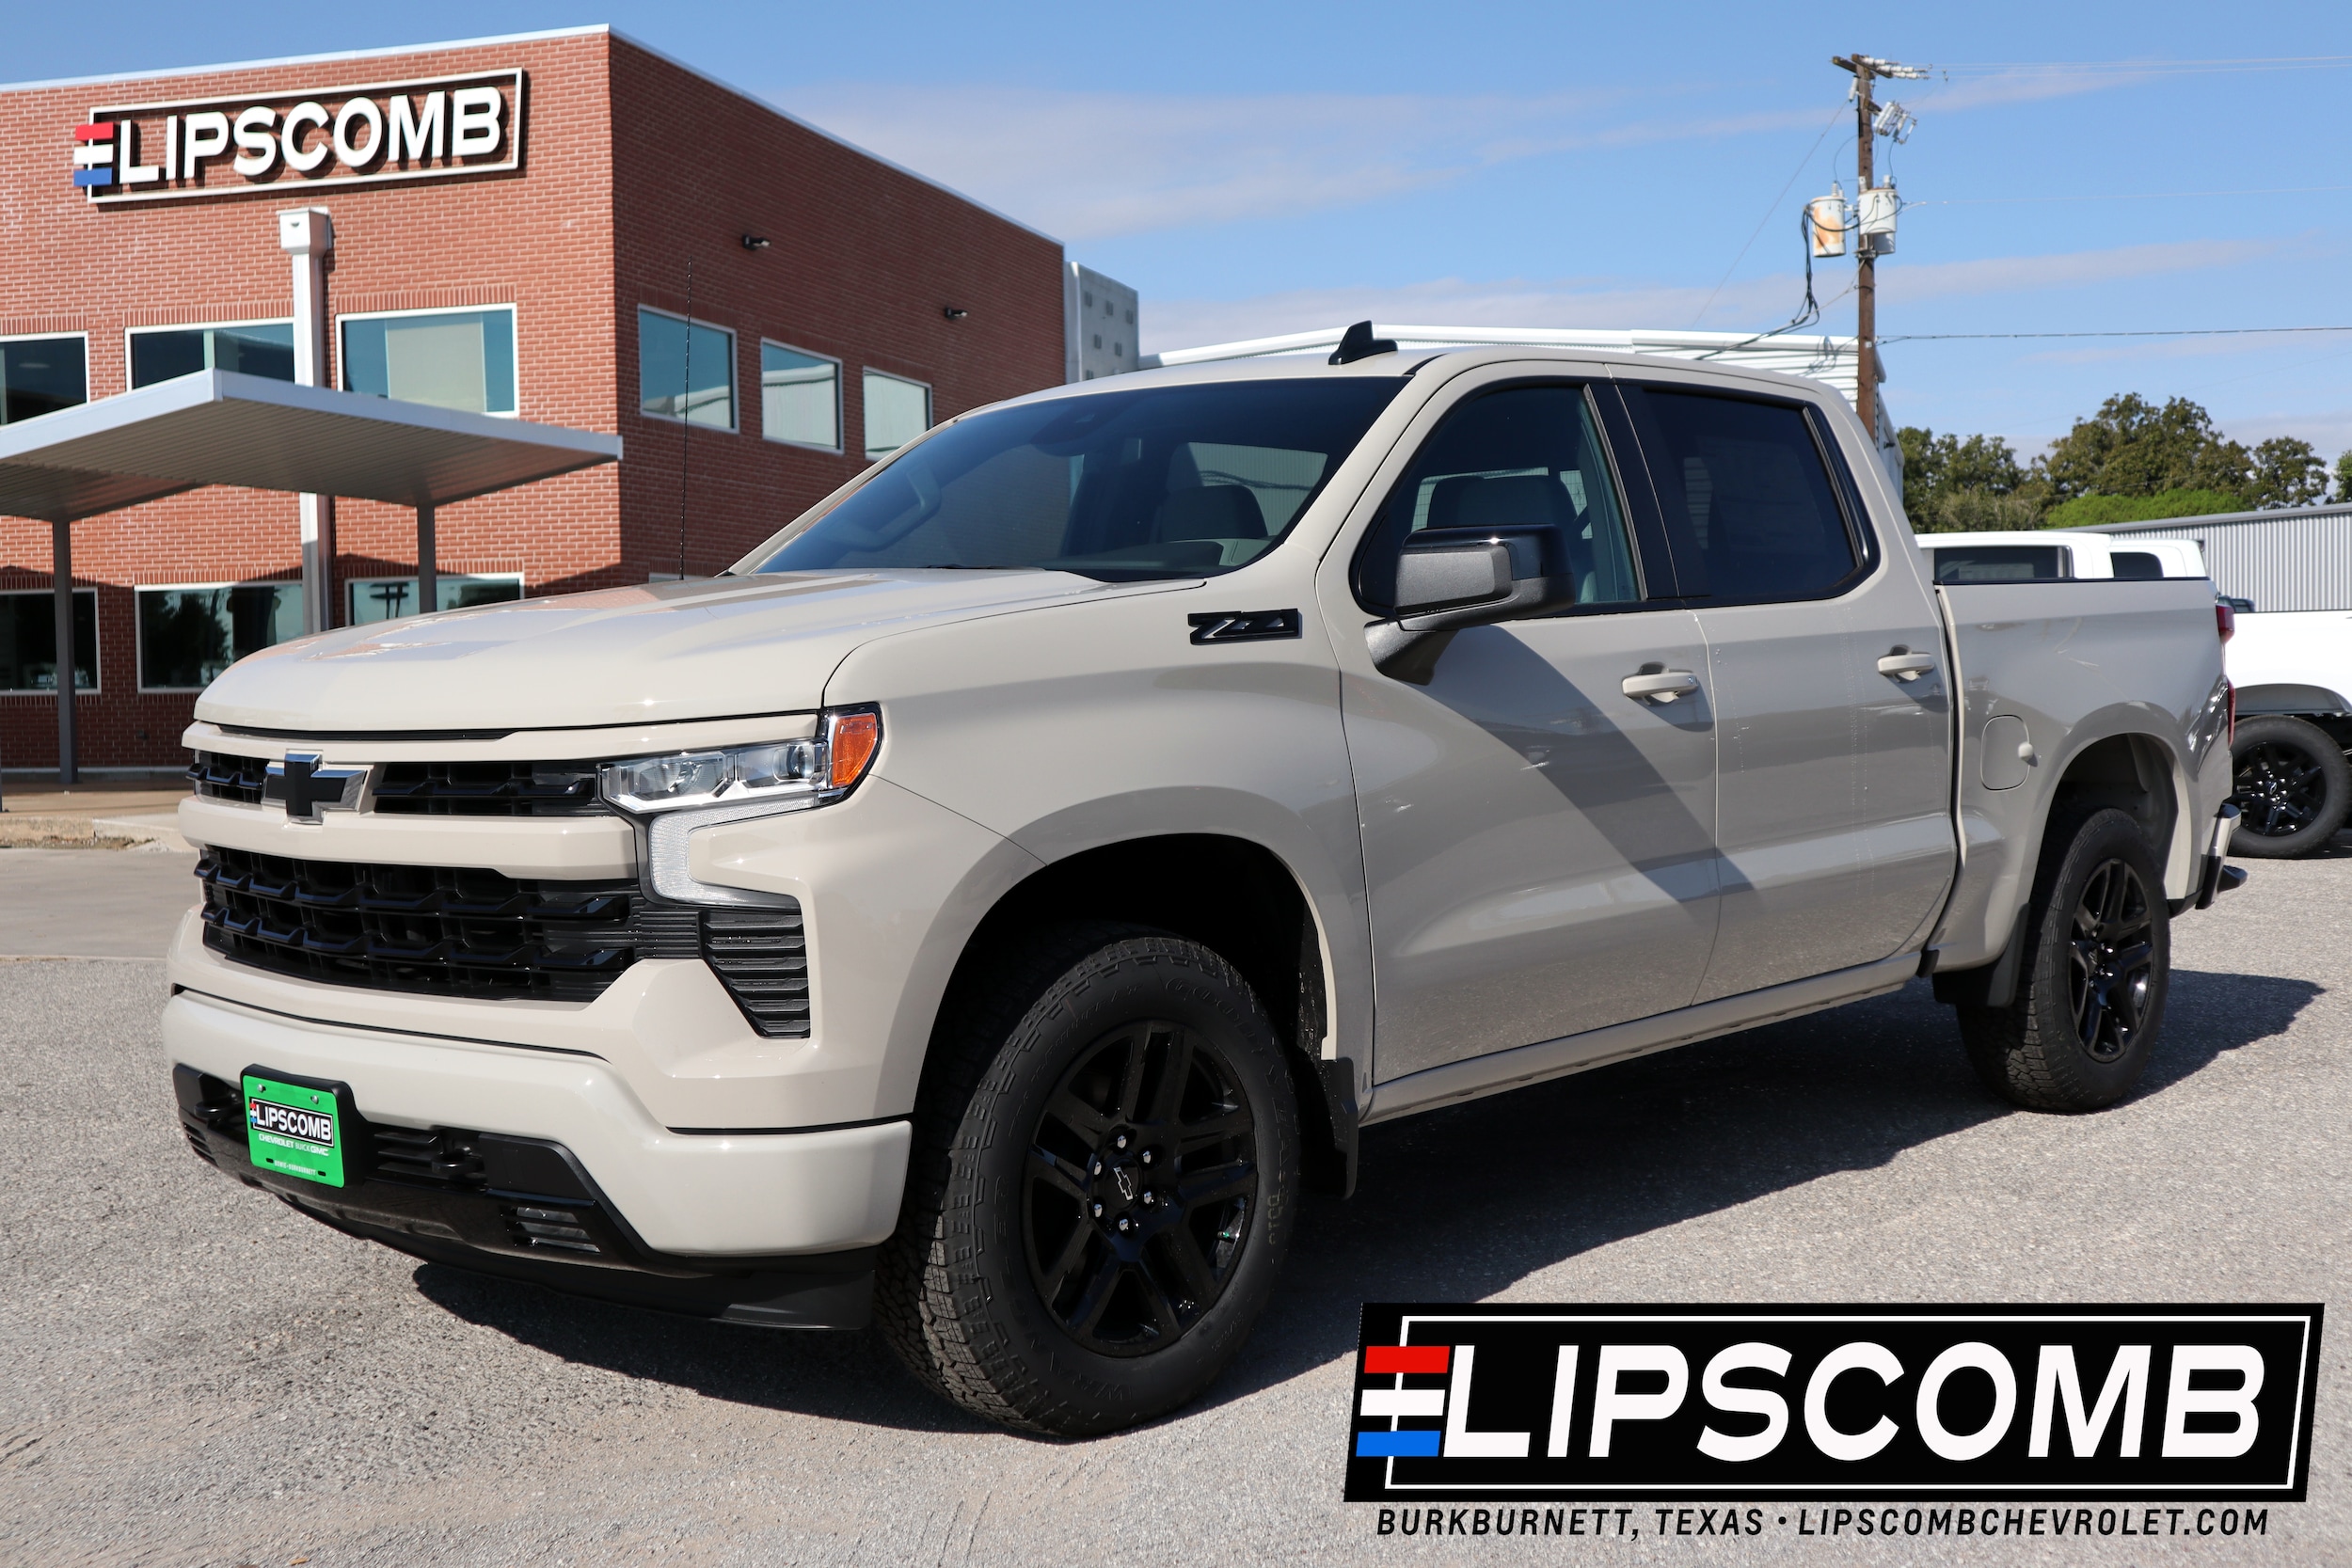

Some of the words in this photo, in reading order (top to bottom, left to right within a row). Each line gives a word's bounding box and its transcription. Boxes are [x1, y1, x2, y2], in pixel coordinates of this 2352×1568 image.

[119, 86, 502, 184] LIPSCOMB
[256, 1104, 331, 1141] LIPSCOMB
[259, 1133, 294, 1148] CHEVROLET
[294, 1142, 310, 1152] BUICK
[310, 1145, 329, 1156] GMC
